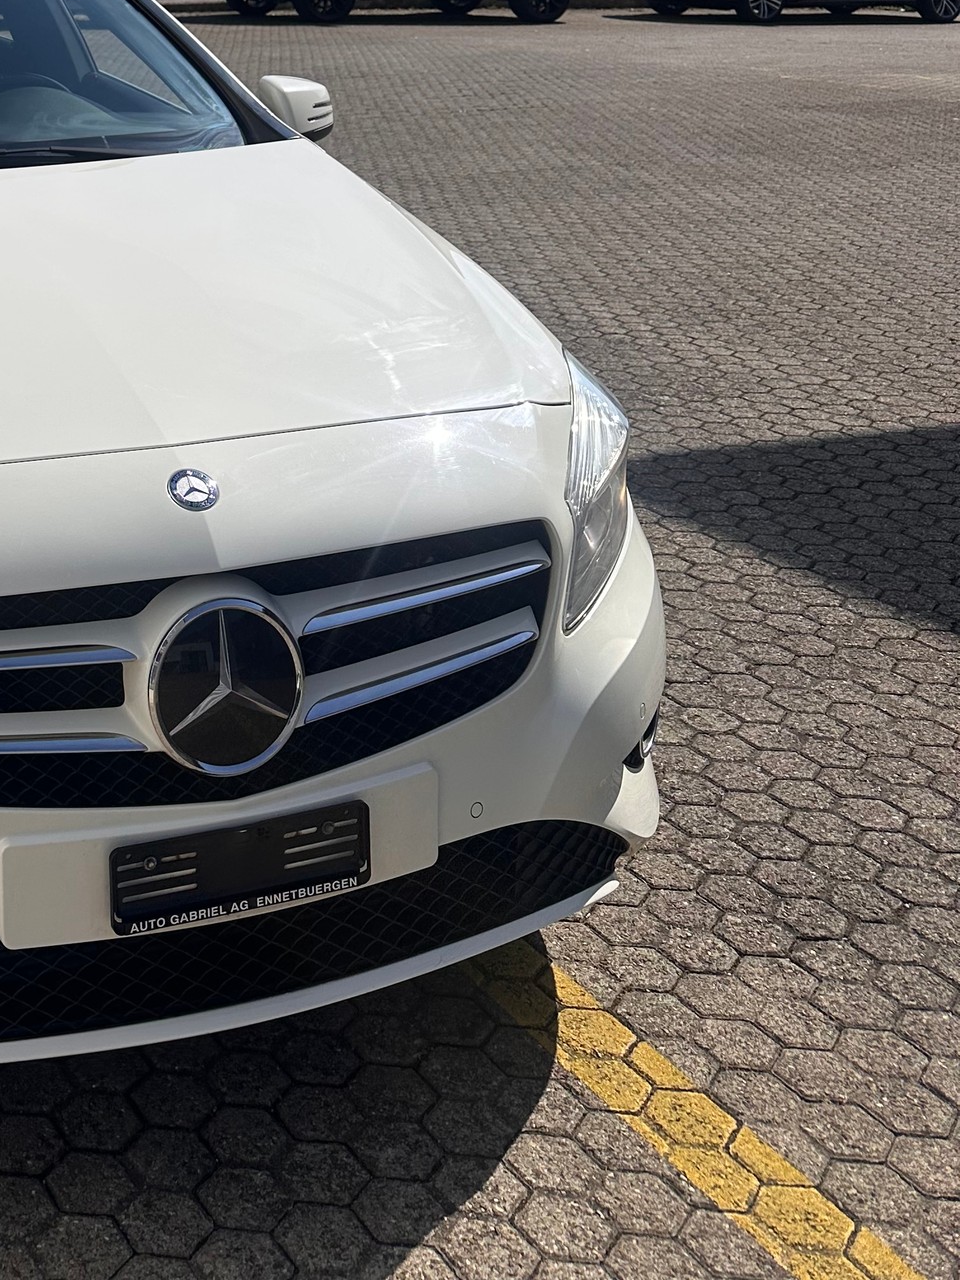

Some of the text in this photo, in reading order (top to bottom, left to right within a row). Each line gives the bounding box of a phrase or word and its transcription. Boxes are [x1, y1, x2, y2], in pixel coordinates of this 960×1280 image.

[130, 876, 358, 934] AUTO GABRIEL AG ENNETBUERGEN
